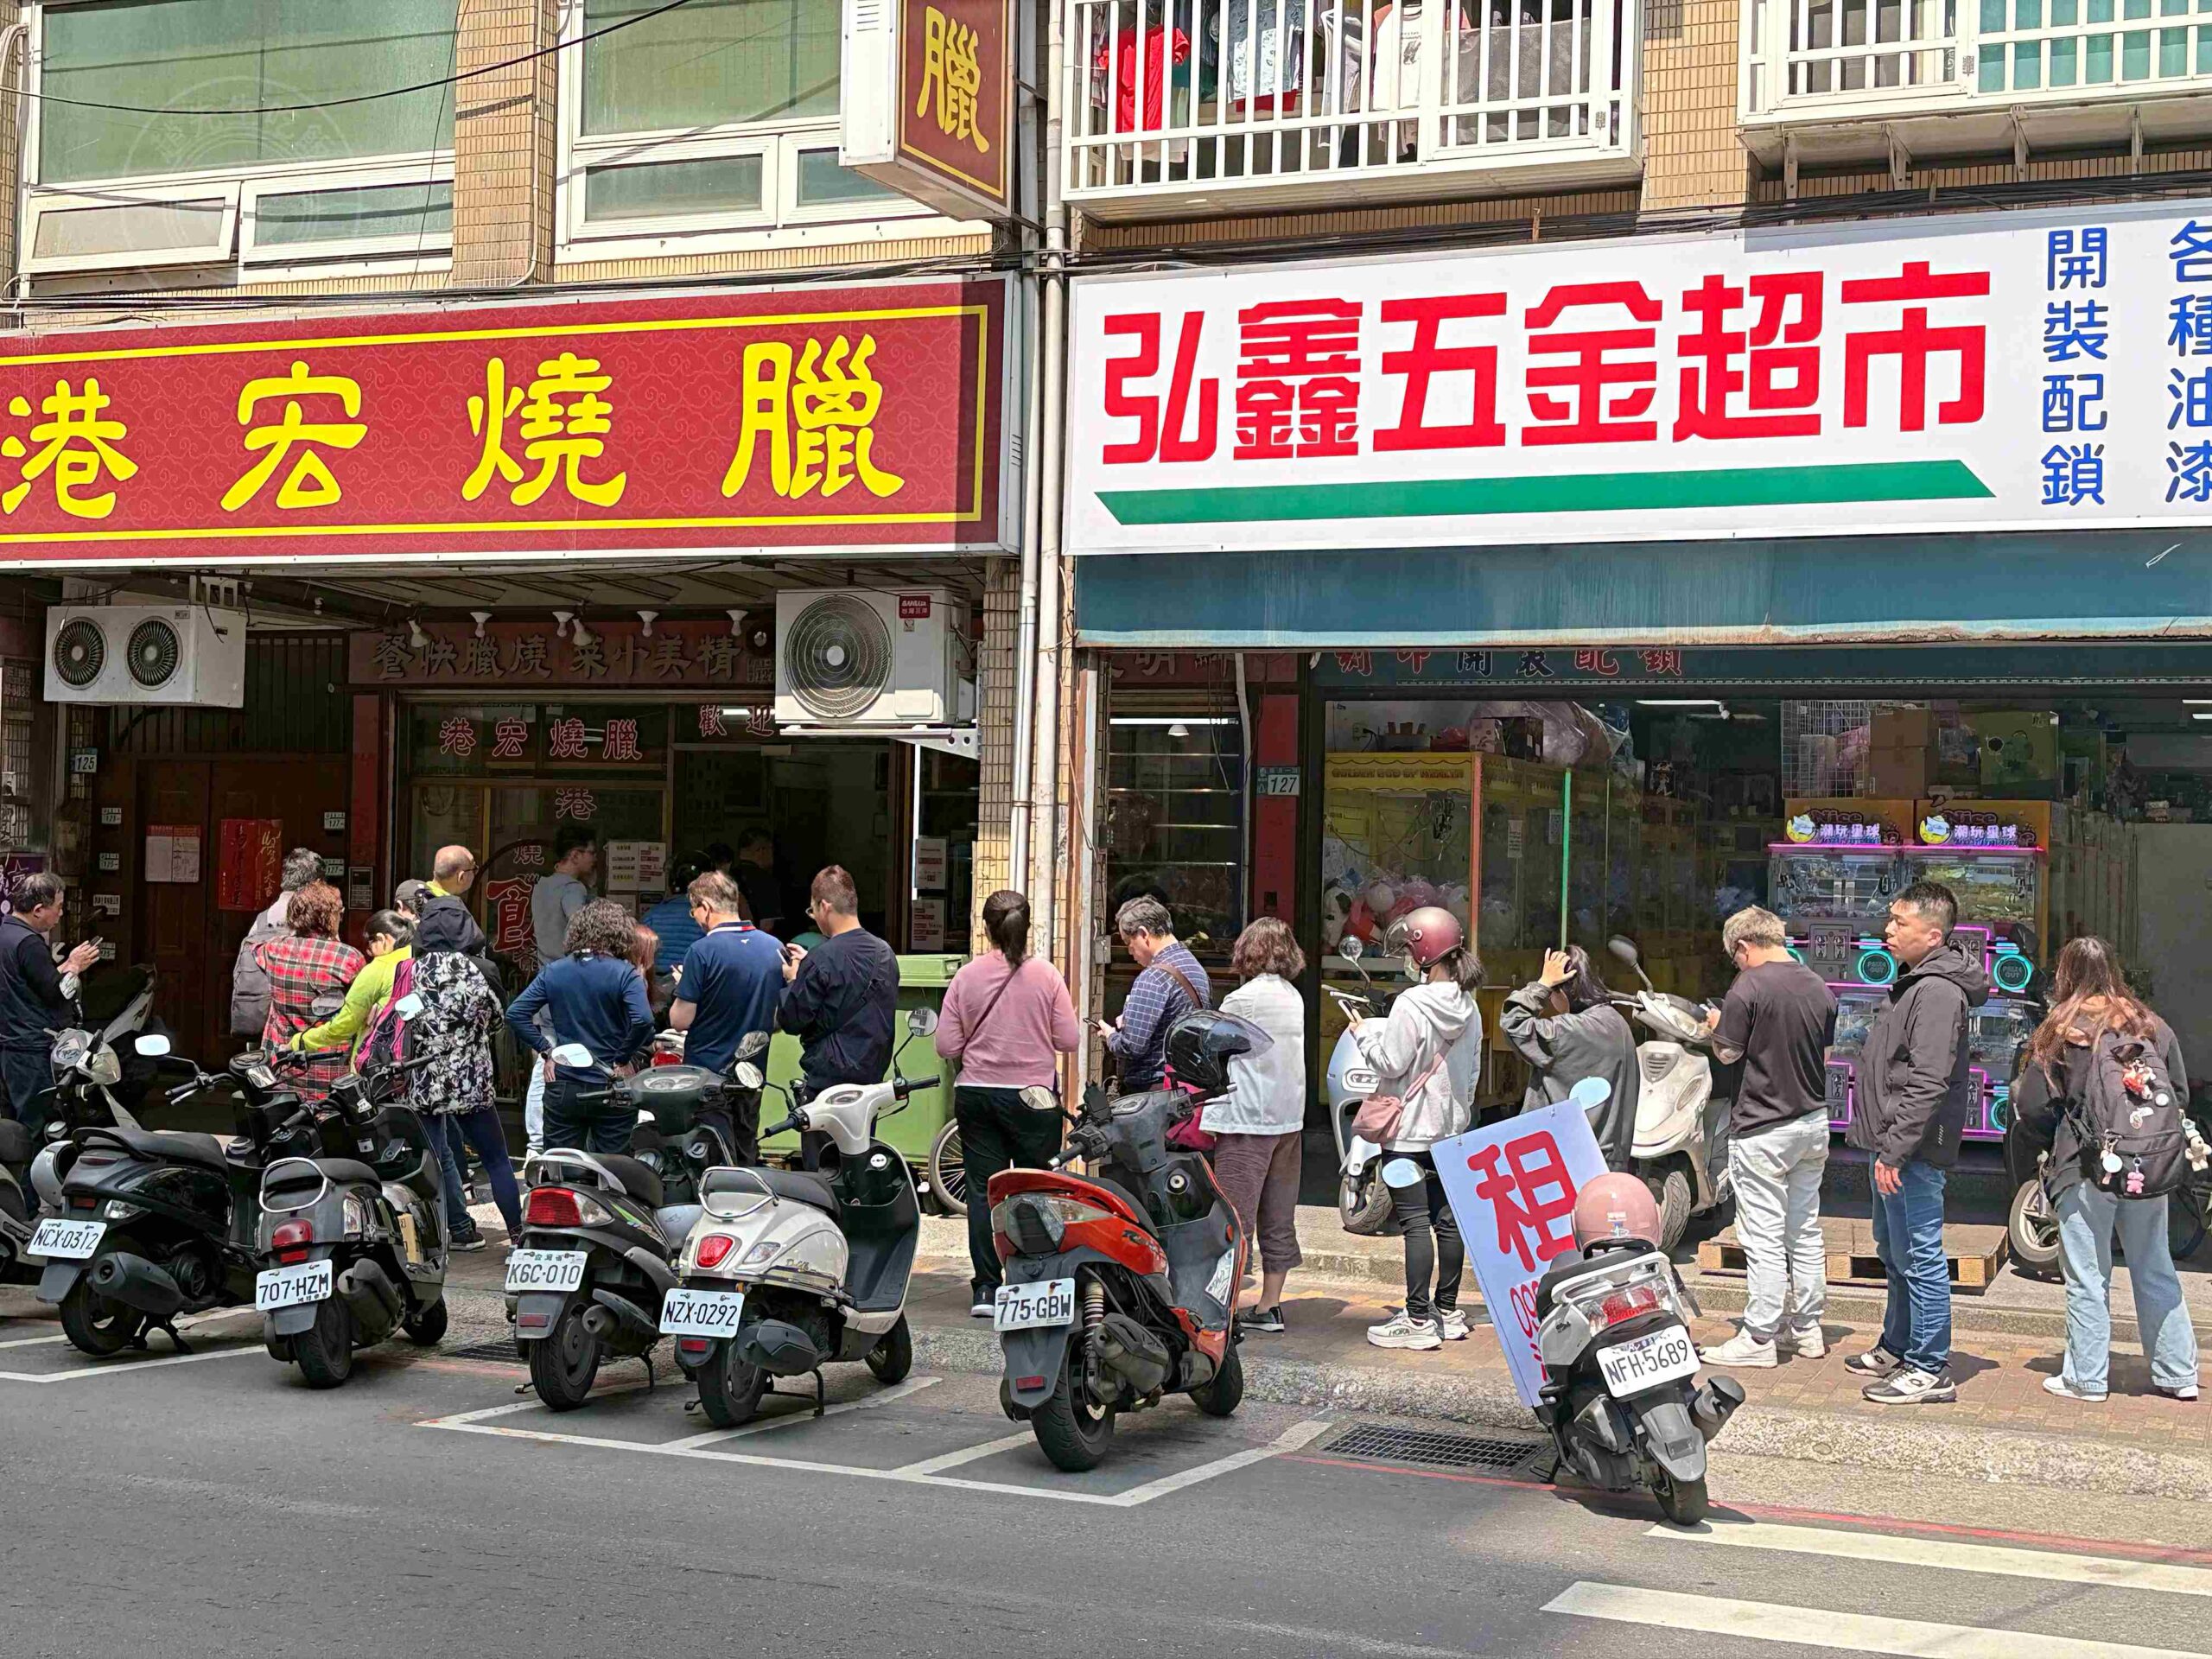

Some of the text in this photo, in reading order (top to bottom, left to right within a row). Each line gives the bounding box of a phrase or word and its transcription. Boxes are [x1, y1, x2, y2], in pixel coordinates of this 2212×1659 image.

[2, 334, 904, 520] 港宏燒臘
[1102, 260, 1992, 464] 弘鑫五金超市
[2041, 226, 2108, 506] 開裝配鎖
[2165, 219, 2212, 503] 各種油漆
[76, 756, 96, 770] 125
[439, 717, 644, 762] 港宏燒臘
[1270, 776, 1297, 793] 127
[1467, 1130, 1577, 1273] 租
